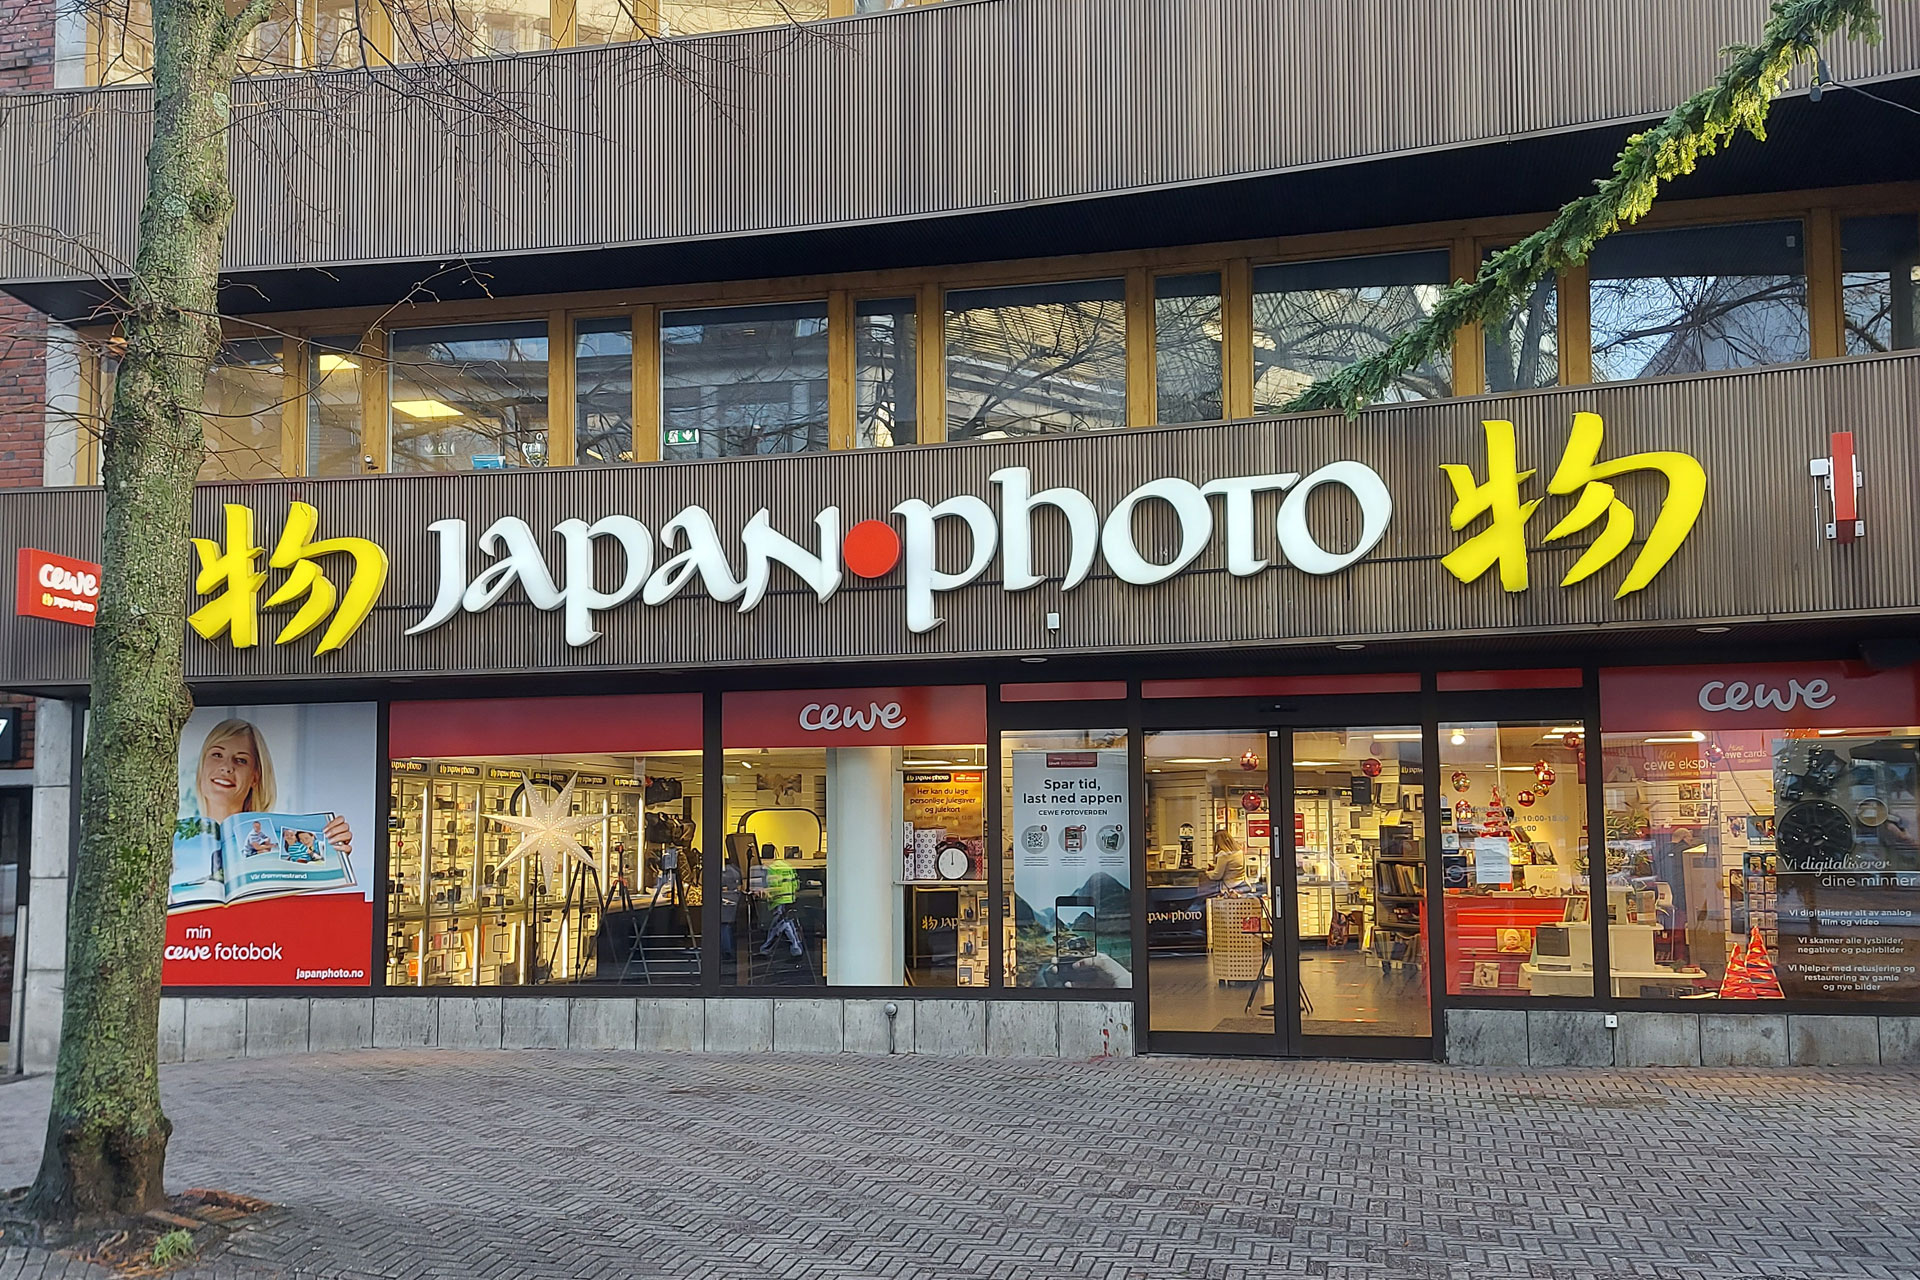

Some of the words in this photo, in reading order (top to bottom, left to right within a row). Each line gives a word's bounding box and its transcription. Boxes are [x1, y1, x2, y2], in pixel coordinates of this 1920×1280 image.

[1439, 411, 1707, 601] 物
[38, 563, 99, 597] cewe
[187, 501, 389, 657] 物
[1698, 678, 1836, 712] cewe
[799, 700, 907, 732] cewe
[1743, 750, 1767, 758] cards
[1643, 760, 1675, 770] cewe
[1044, 779, 1075, 791] Spar
[1078, 778, 1101, 791] tid,
[1023, 792, 1047, 803] last
[1051, 792, 1076, 803] ned
[1080, 793, 1122, 805] appen
[1782, 858, 1797, 870] Vi
[1800, 853, 1891, 877] digitaliserer
[1822, 874, 1856, 887] dine
[1861, 874, 1916, 887] minner
[1800, 909, 1853, 917] digitaliserer
[1881, 909, 1912, 917] analog
[1821, 918, 1838, 926] film
[1855, 918, 1879, 926] video
[186, 924, 211, 939] min
[1809, 936, 1843, 944] skanner
[1864, 937, 1904, 946] lysbilder,
[164, 945, 212, 960] cewe
[214, 942, 283, 960] fotobok
[1798, 946, 1838, 955] negativer
[1855, 946, 1904, 955] papirbilder
[295, 968, 364, 979] japanphoto.no
[1788, 964, 1797, 972] Vi
[1799, 964, 1829, 973] hjelper
[1832, 964, 1851, 972] med
[1853, 964, 1901, 973] retusjering
[1804, 974, 1857, 982] restaurering
[1872, 974, 1899, 982] gamle
[1855, 983, 1881, 991] bilder
